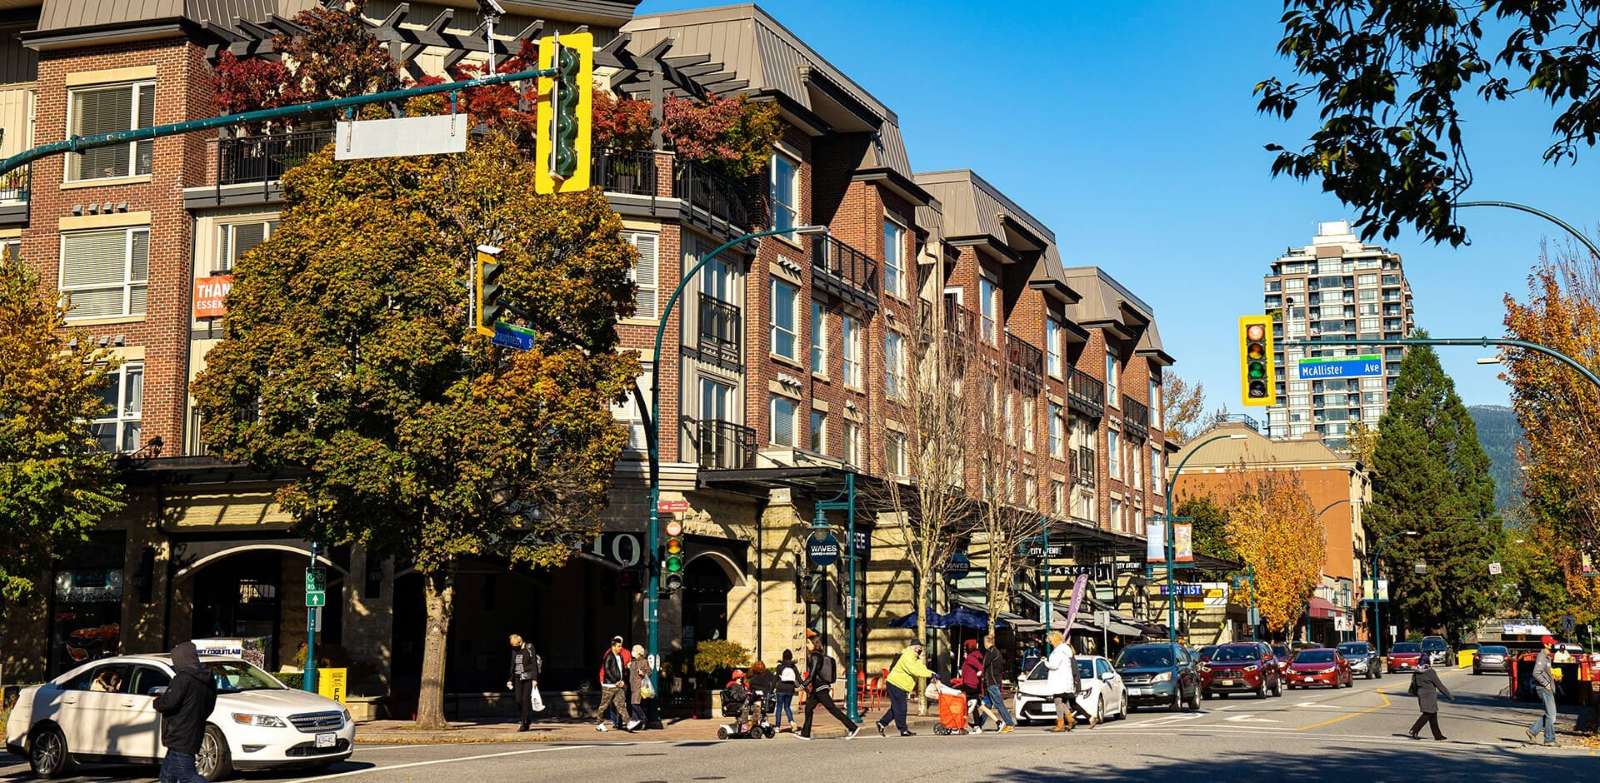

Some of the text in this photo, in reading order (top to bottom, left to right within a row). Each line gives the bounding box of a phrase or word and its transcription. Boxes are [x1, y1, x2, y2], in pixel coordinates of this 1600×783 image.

[1302, 363, 1380, 376] McAllister Ave
[810, 544, 838, 552] WAVES
